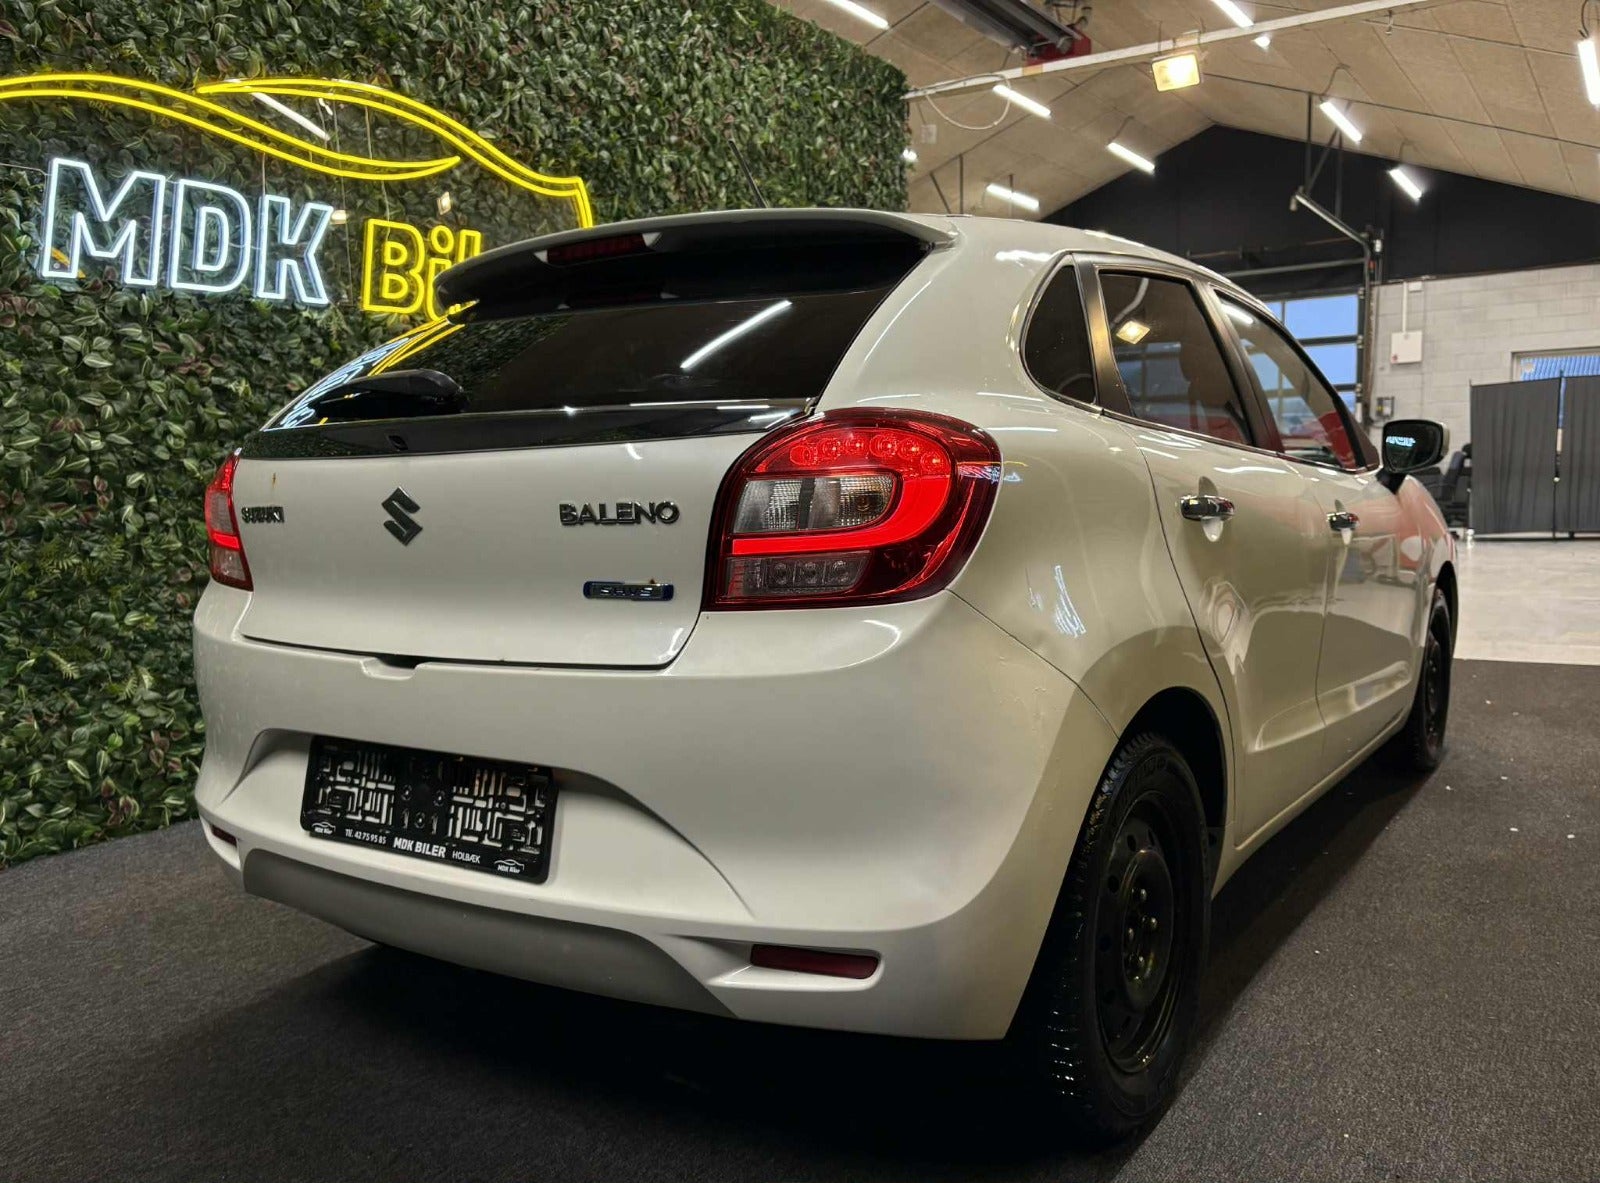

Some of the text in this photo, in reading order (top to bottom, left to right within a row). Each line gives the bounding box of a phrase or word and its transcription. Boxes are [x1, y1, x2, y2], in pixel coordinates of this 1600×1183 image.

[42, 157, 334, 306] MDK
[559, 500, 680, 526] BALENO
[354, 831, 362, 840] 42
[362, 832, 370, 841] 75
[370, 834, 378, 843] 95
[378, 835, 387, 845] 85
[393, 837, 447, 858] MDK BILER
[452, 850, 481, 864] HOLBÆK
